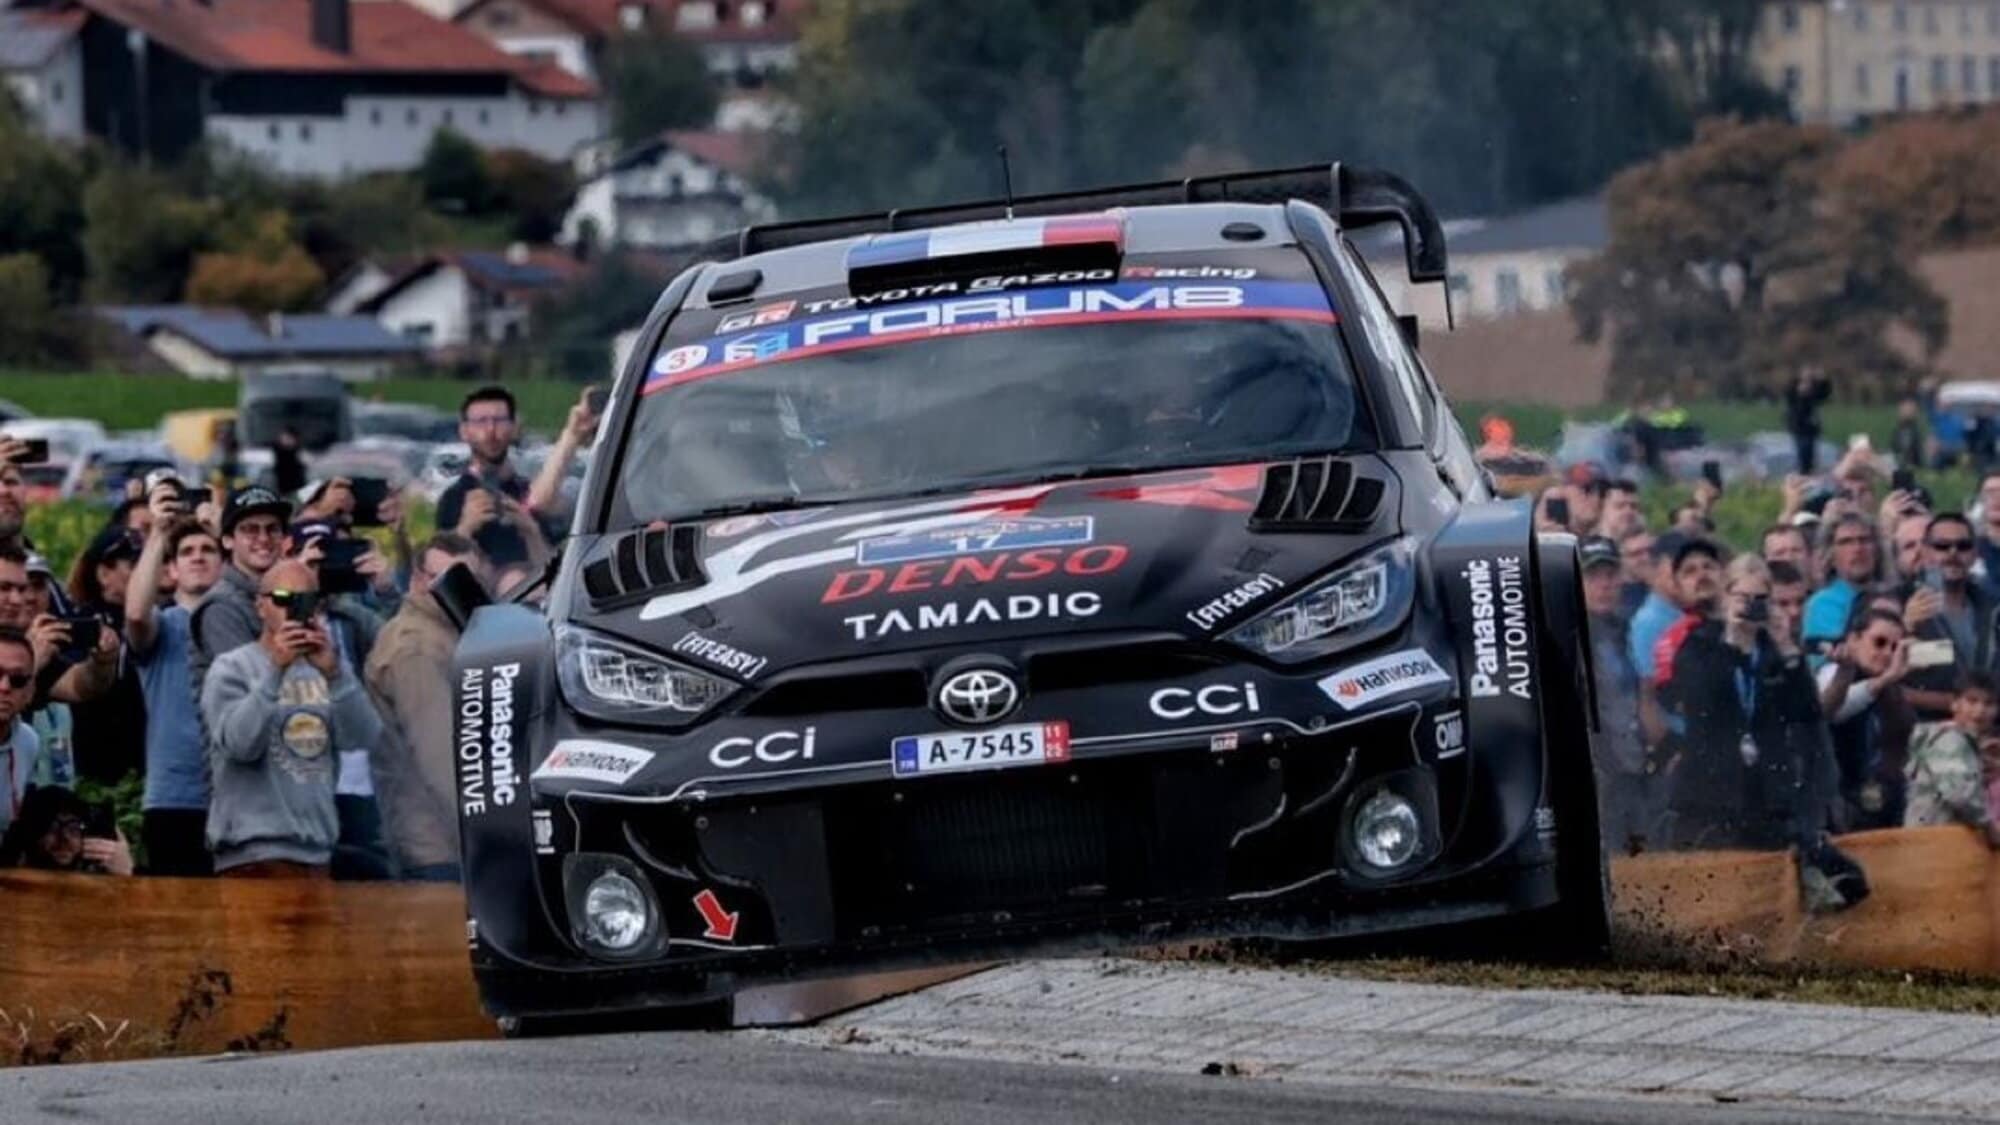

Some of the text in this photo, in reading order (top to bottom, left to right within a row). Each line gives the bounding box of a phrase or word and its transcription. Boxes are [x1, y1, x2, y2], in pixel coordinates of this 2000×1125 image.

[803, 287, 1244, 346] FORUM8
[804, 266, 1257, 313] TOYOTA GAZOO Racing
[952, 535, 1001, 552] 17
[821, 544, 1129, 603] DENSO
[844, 592, 1102, 640] TAMADIC
[1461, 559, 1501, 697] Panasonic
[1497, 556, 1531, 699] AUTOMOTIVE
[459, 667, 486, 817] AUTOMOTIVE
[490, 662, 521, 807] Panasonic
[929, 732, 1034, 764] A-7545
